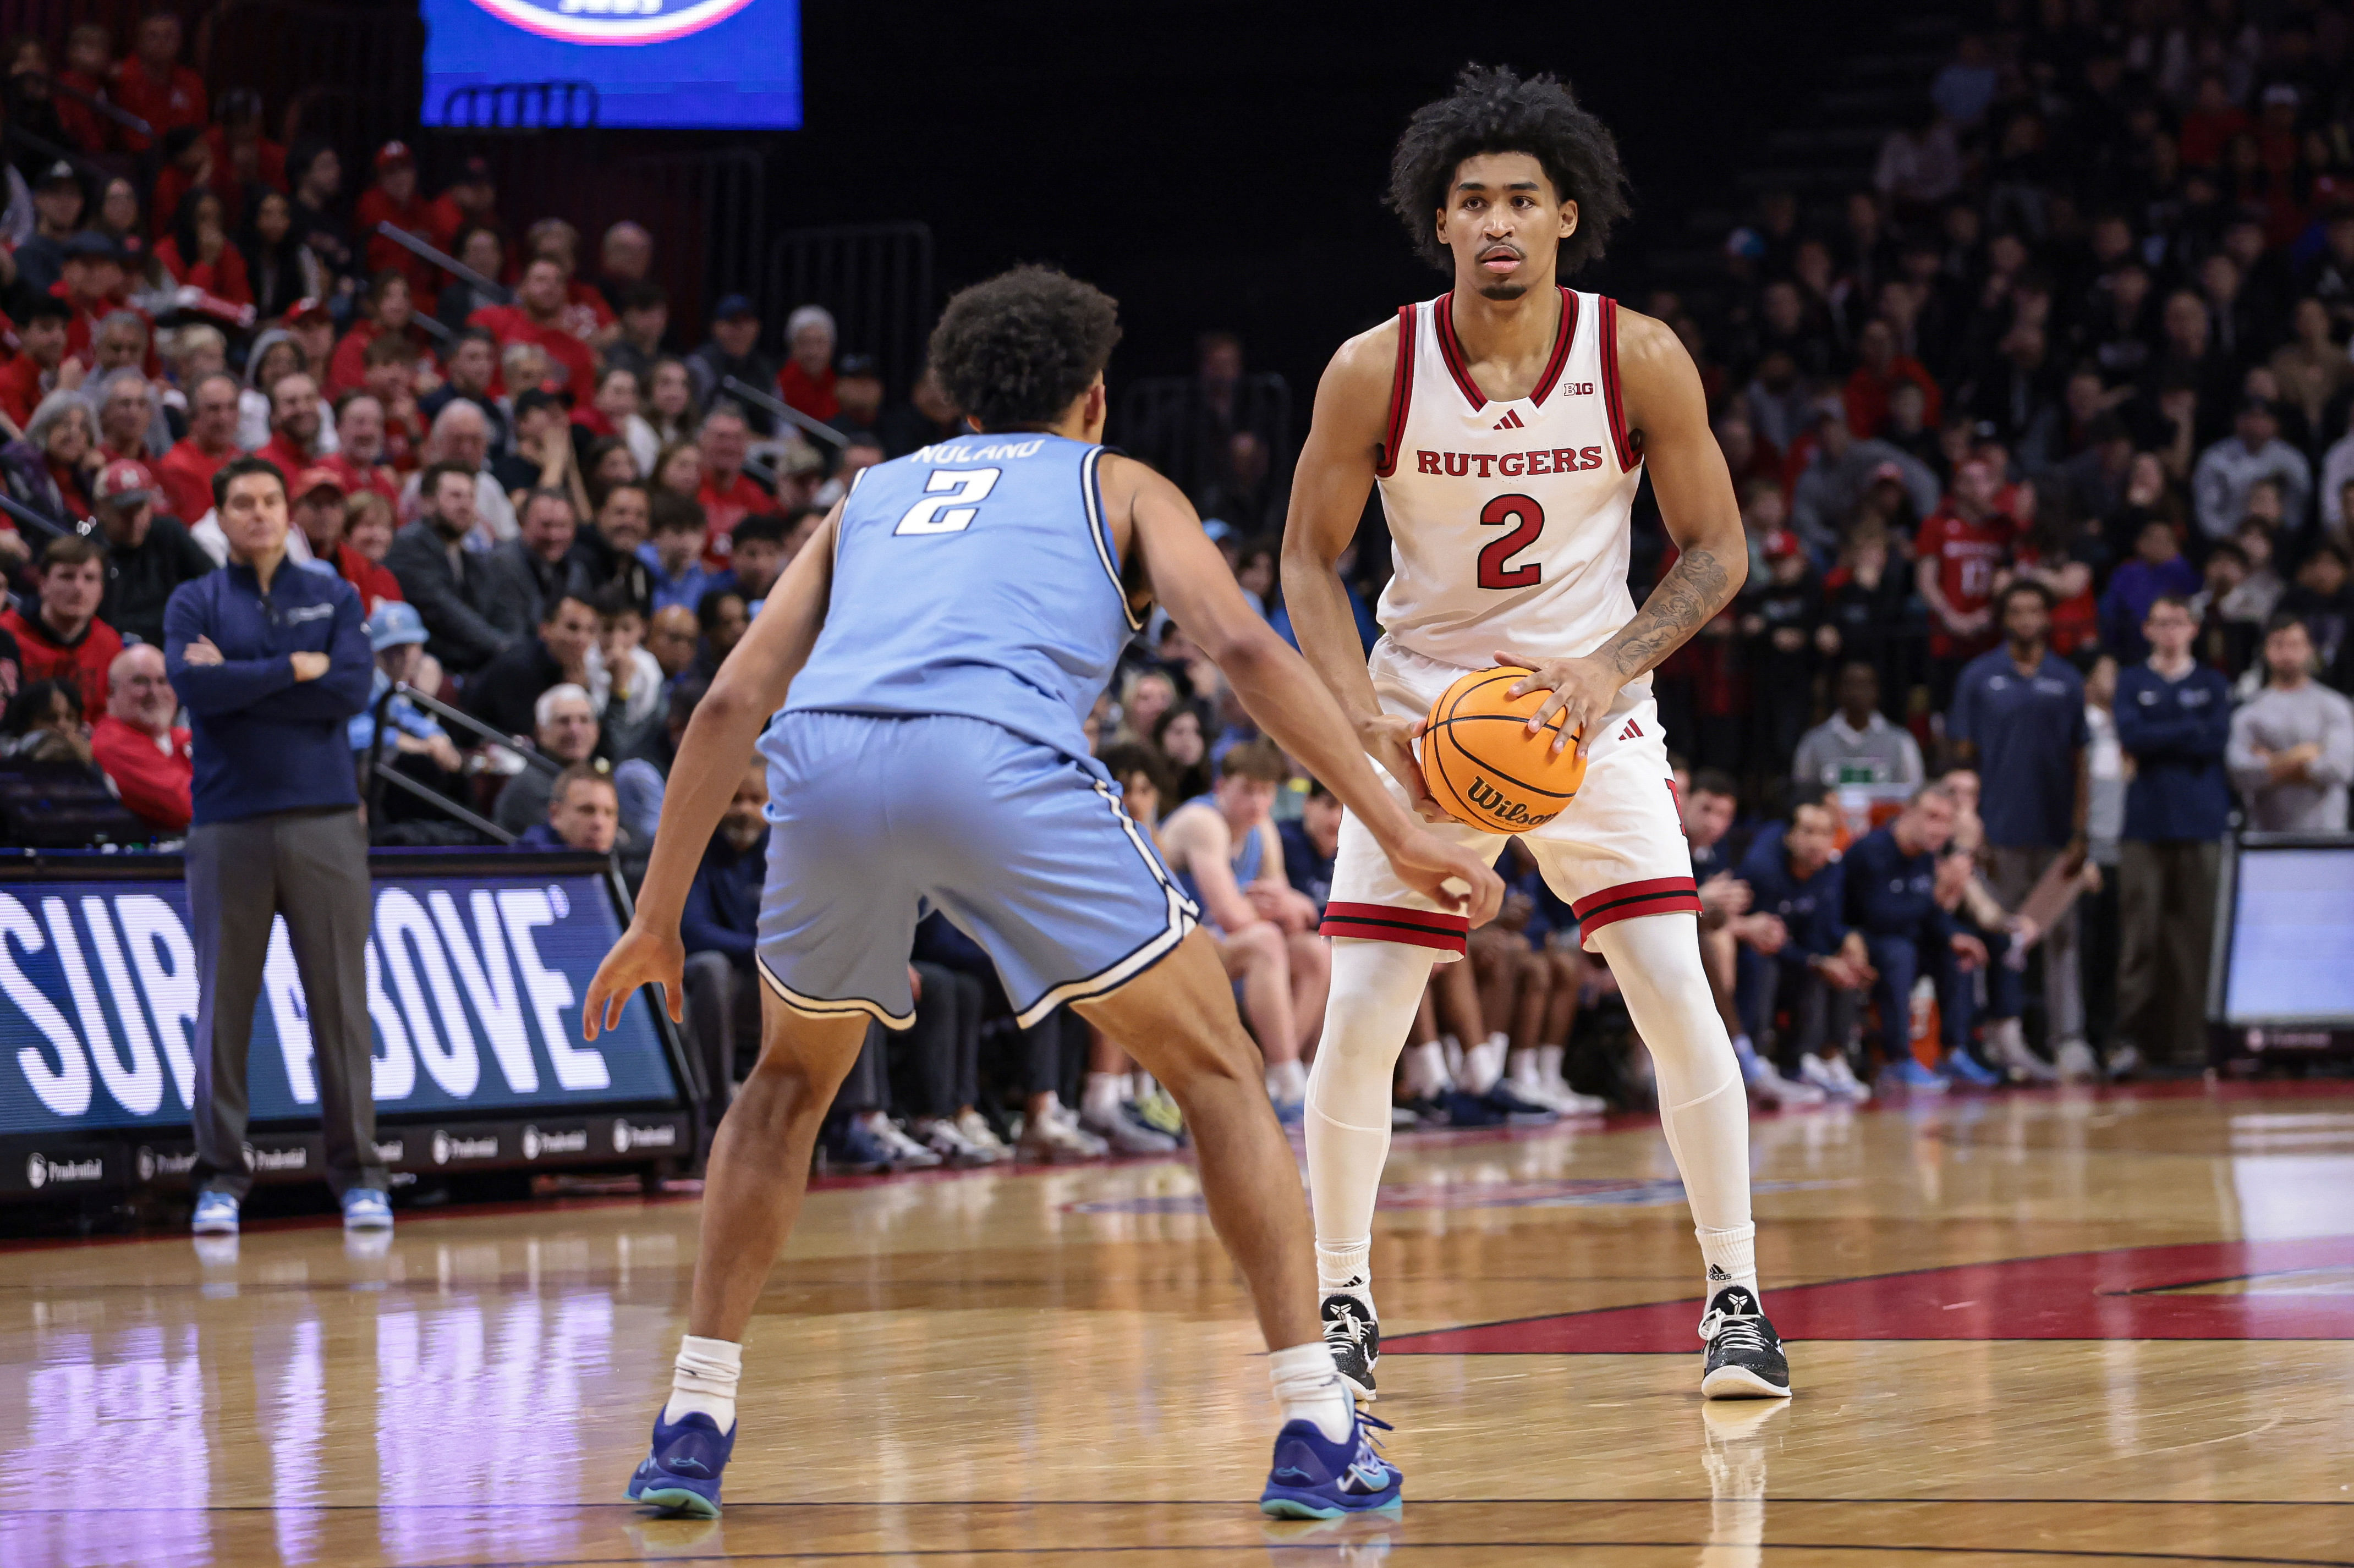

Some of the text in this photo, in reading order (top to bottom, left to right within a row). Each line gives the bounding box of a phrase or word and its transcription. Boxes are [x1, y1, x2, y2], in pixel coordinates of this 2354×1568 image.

[1417, 445, 1603, 478] RUTGERS
[892, 467, 1002, 536] 2
[1477, 493, 1545, 590] 2
[48, 1158, 102, 1182] Prudential
